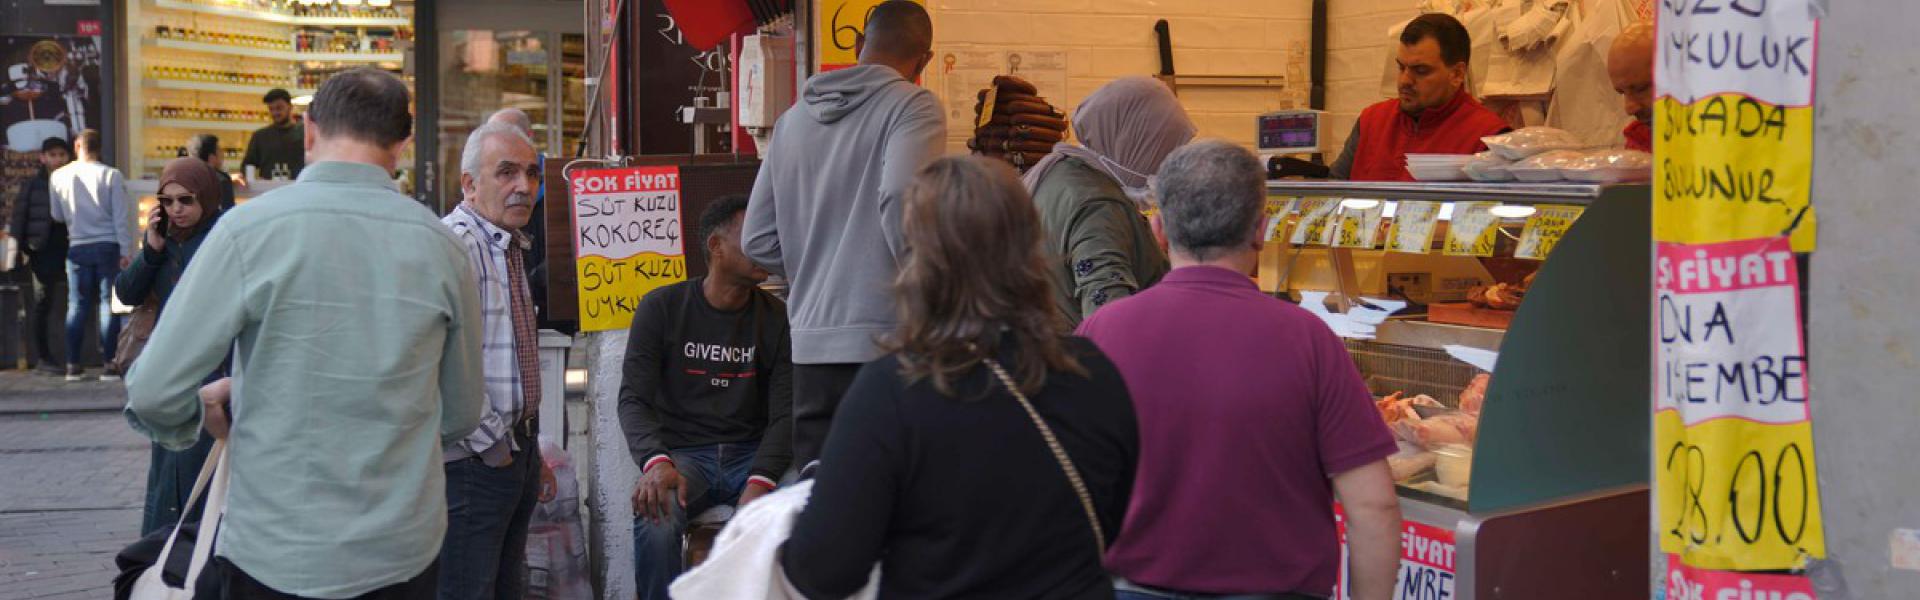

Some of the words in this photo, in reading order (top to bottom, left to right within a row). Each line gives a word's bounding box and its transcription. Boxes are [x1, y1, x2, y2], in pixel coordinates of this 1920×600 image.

[574, 176, 618, 194] ŞOK
[625, 169, 678, 191] FİYAT
[634, 194, 677, 213] KUZU
[580, 218, 679, 248] KOKOREÇ
[634, 258, 684, 280] KUZU
[1679, 249, 1791, 290] FİYAT
